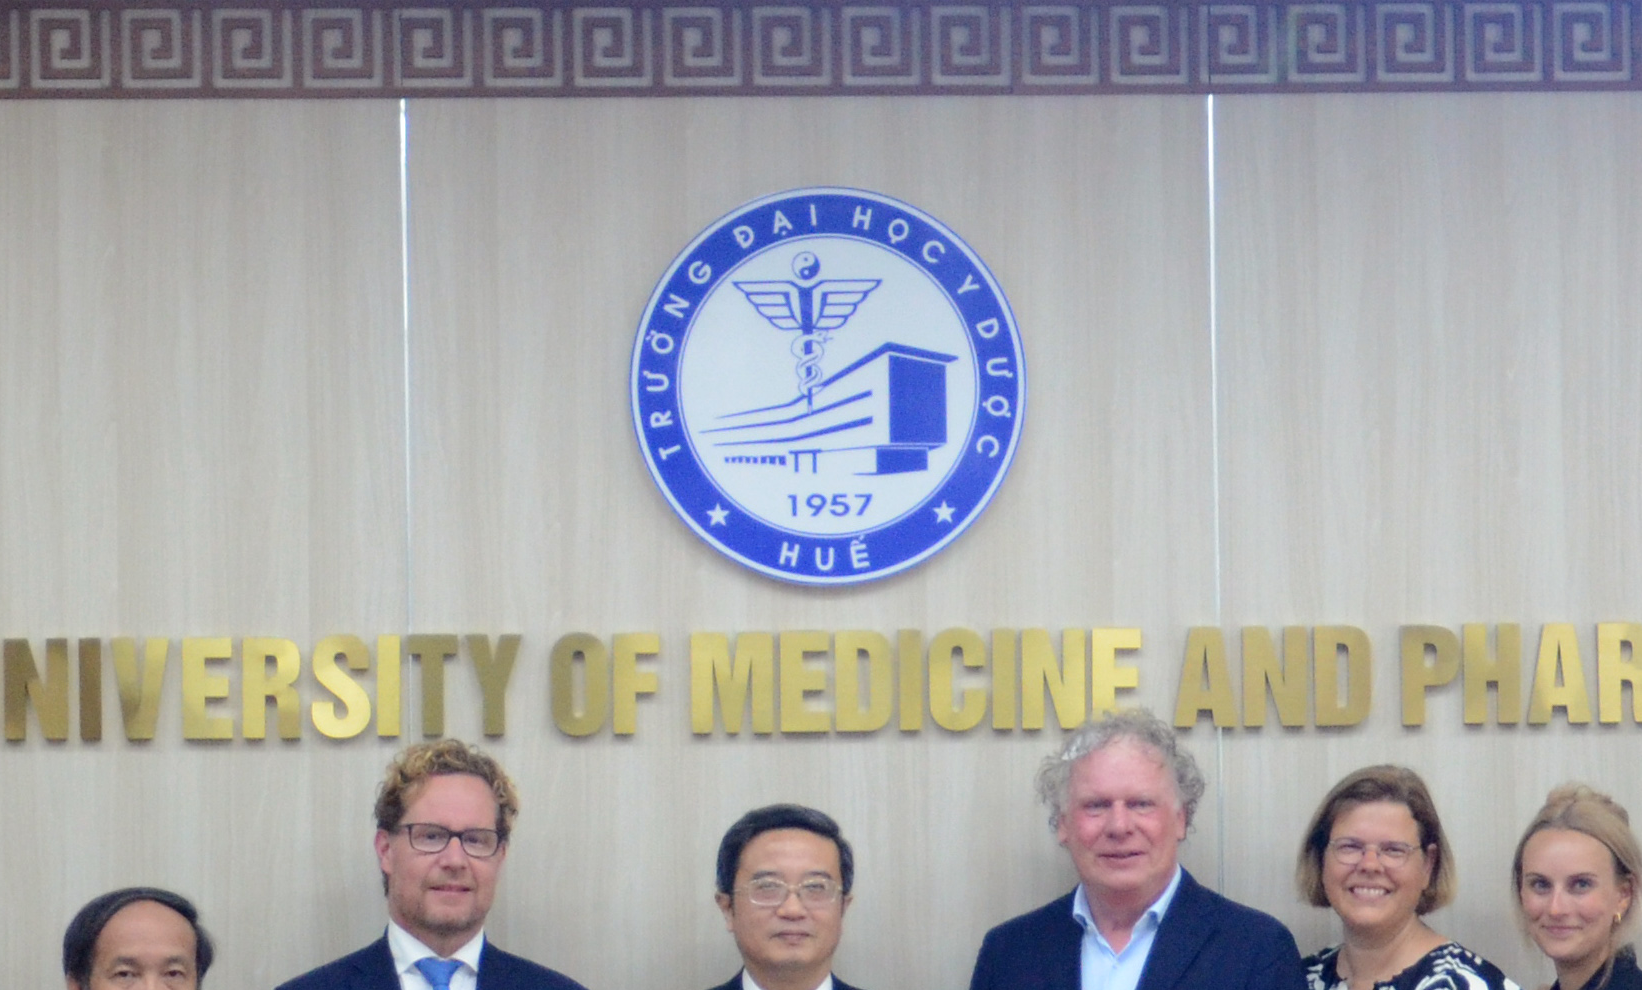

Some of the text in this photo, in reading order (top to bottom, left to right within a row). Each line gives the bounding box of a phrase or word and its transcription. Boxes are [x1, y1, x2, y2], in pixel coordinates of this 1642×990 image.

[643, 204, 1014, 461] TRƯỜNG ĐẠI HỌC Y DƯỢC
[786, 492, 874, 518] 1957
[778, 534, 871, 571] HUẾ
[550, 632, 661, 736] OF
[689, 626, 1144, 734] MEDICINE
[1173, 625, 1373, 728] AND
